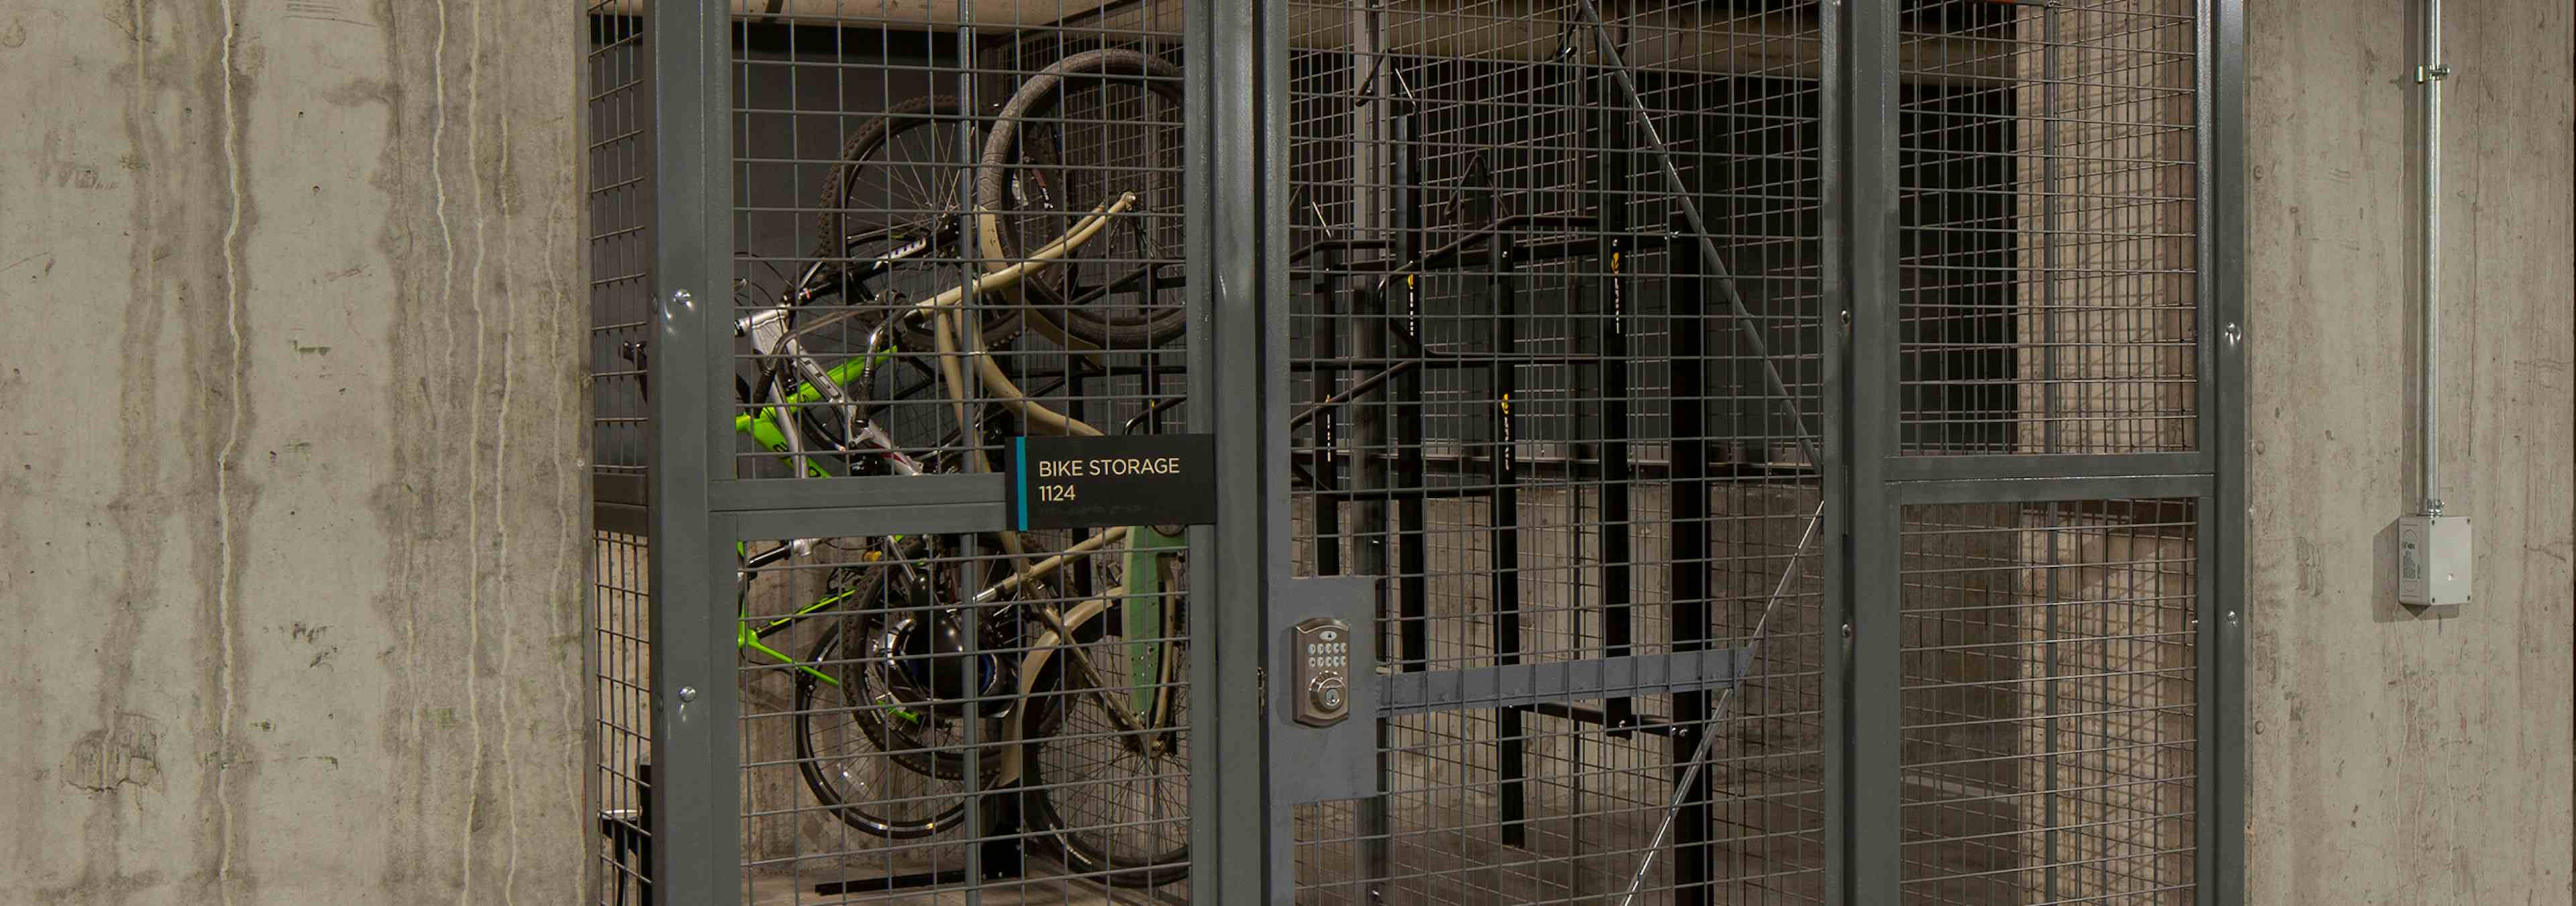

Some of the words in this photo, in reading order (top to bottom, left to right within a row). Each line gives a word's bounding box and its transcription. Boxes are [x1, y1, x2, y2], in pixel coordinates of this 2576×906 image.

[1039, 460, 1083, 477] BIKE
[1089, 458, 1180, 476] STORAGE
[1038, 485, 1076, 501] 1124
